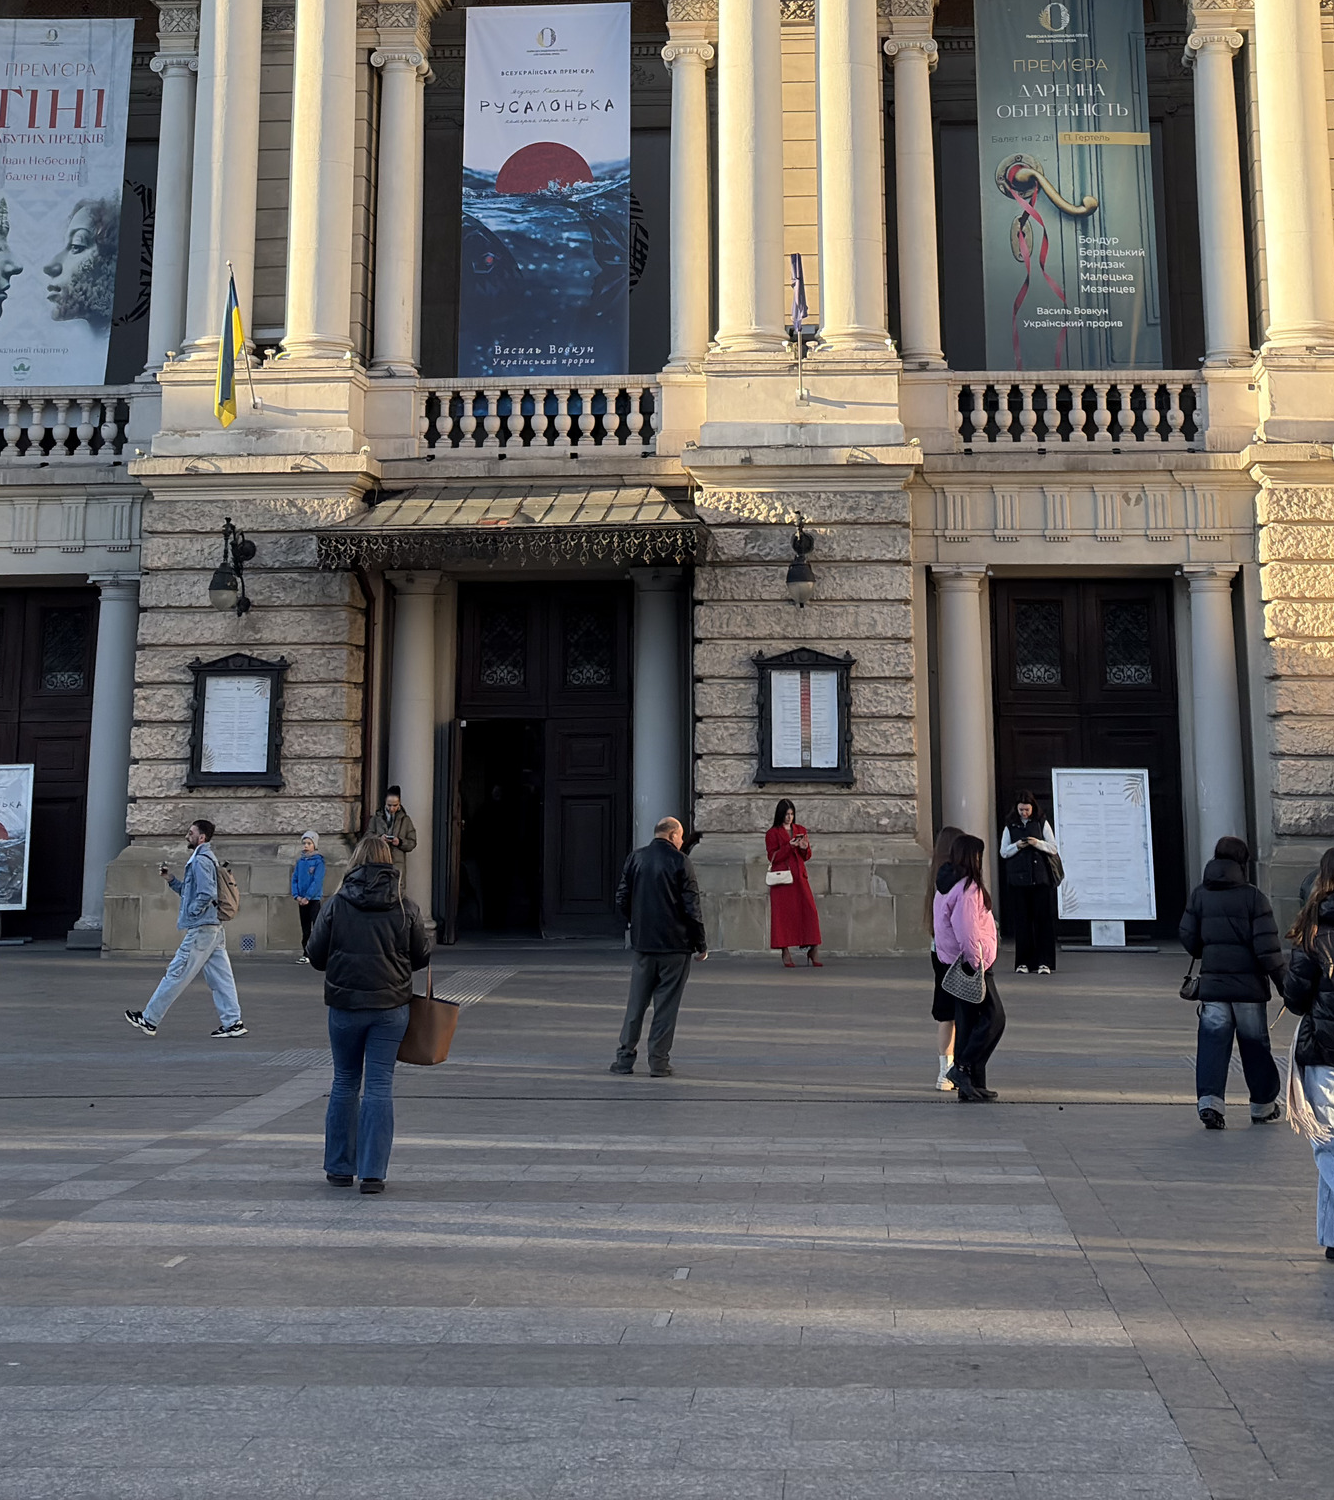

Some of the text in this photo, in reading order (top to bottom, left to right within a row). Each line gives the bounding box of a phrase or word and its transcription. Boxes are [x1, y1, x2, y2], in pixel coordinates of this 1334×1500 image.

[5, 62, 97, 77] ПРЕМ'ЄРА
[1013, 58, 1109, 73] ПРЕМ'ЄРА
[500, 69, 557, 77] ВСЕУКРАЇНСЬКА
[1018, 83, 1106, 99] ДАРЕМНА
[480, 98, 615, 115] РУСАЛОНЬКА
[996, 103, 1129, 119] ОБЕРЕЖНІСТЬ
[49, 133, 104, 145] ПРЕДКІВ
[991, 135, 1019, 144] Балет
[1035, 134, 1041, 142] 2
[1063, 134, 1110, 143] П. Гертель
[2, 156, 86, 166] Іван Небесний
[5, 171, 37, 181] балет
[41, 173, 55, 181] на
[57, 171, 65, 181] 2
[1078, 235, 1119, 246] Бондур
[1079, 248, 1146, 257] Бервецький
[1079, 260, 1125, 270] Риндзак
[1080, 272, 1134, 282] Малецька
[1081, 285, 1136, 294] Мезенцев
[1036, 306, 1109, 317] Василь Вовкун
[1023, 319, 1123, 329] Український прорив
[494, 344, 594, 356] Василь Вовкун
[492, 357, 557, 368] Український
